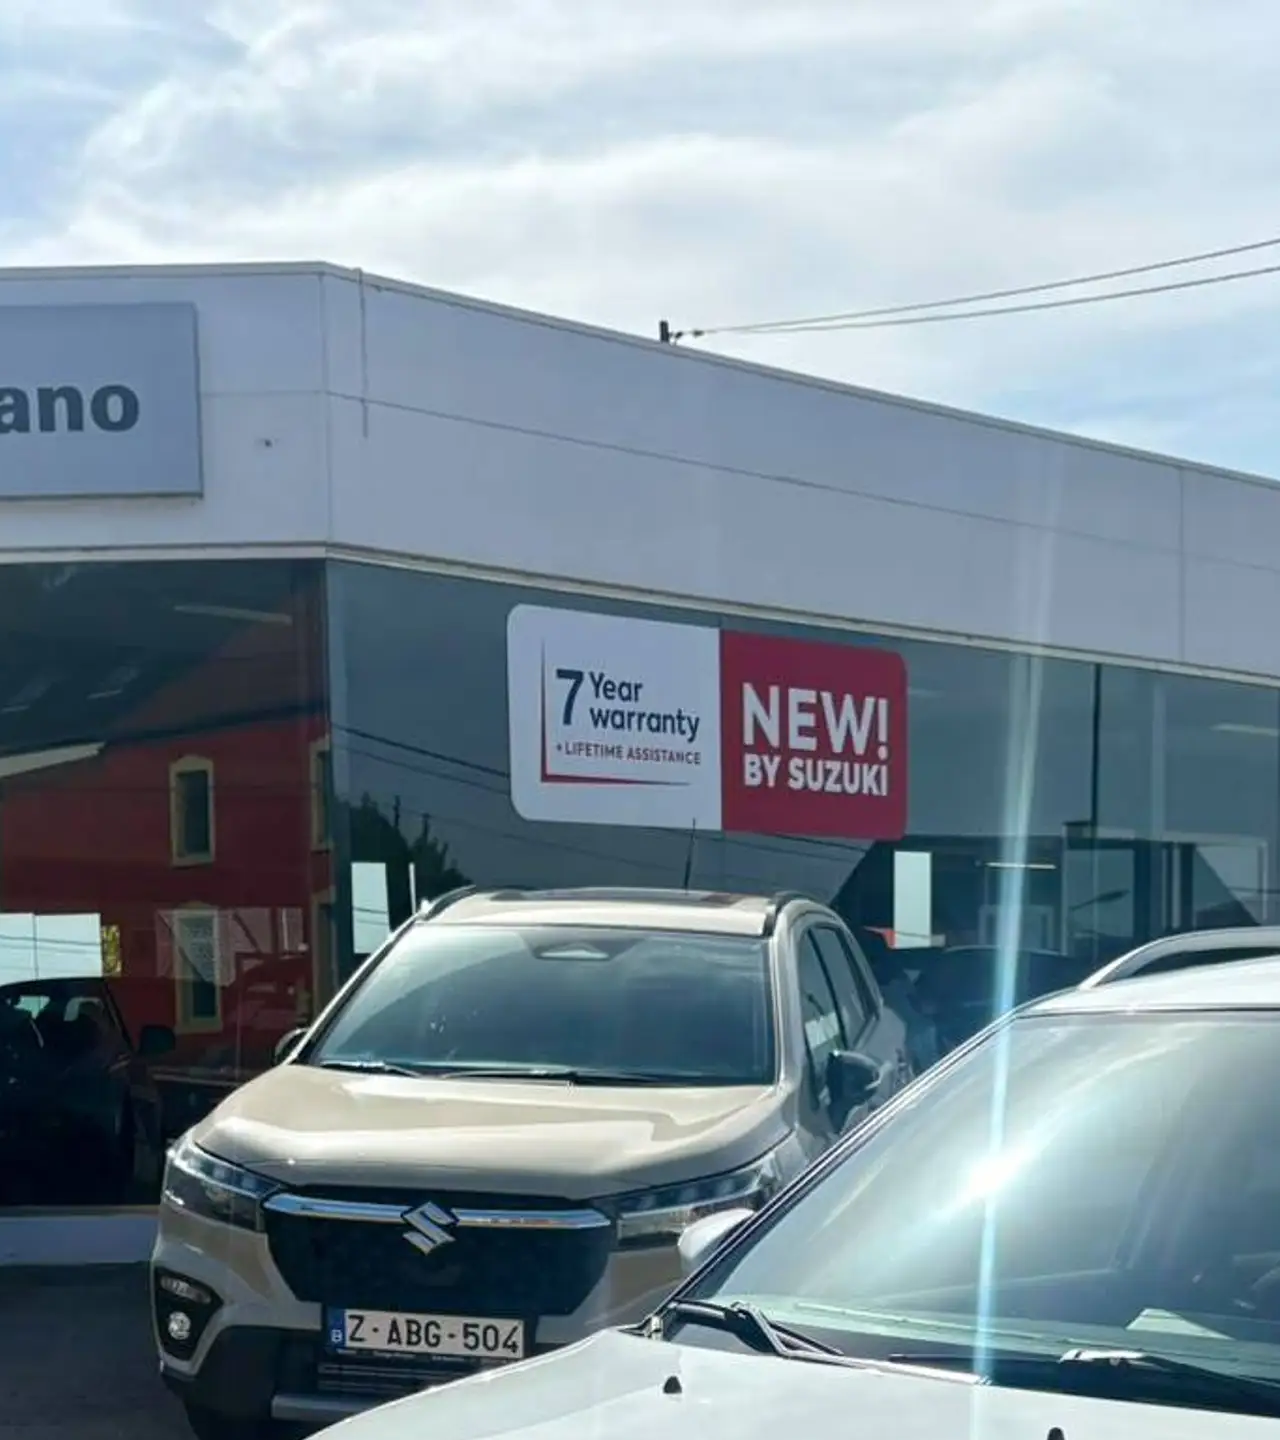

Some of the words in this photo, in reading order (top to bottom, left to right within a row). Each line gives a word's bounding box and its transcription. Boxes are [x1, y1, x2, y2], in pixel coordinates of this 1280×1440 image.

[556, 669, 584, 726] 7
[589, 672, 644, 702] Year
[590, 706, 701, 742] warranty
[742, 682, 889, 760] NEW!
[564, 740, 623, 760] LIFETIME
[626, 747, 701, 766] ASSISTANCE
[743, 753, 781, 787] BY
[788, 756, 889, 797] SUZUKI
[331, 1329, 343, 1344] B
